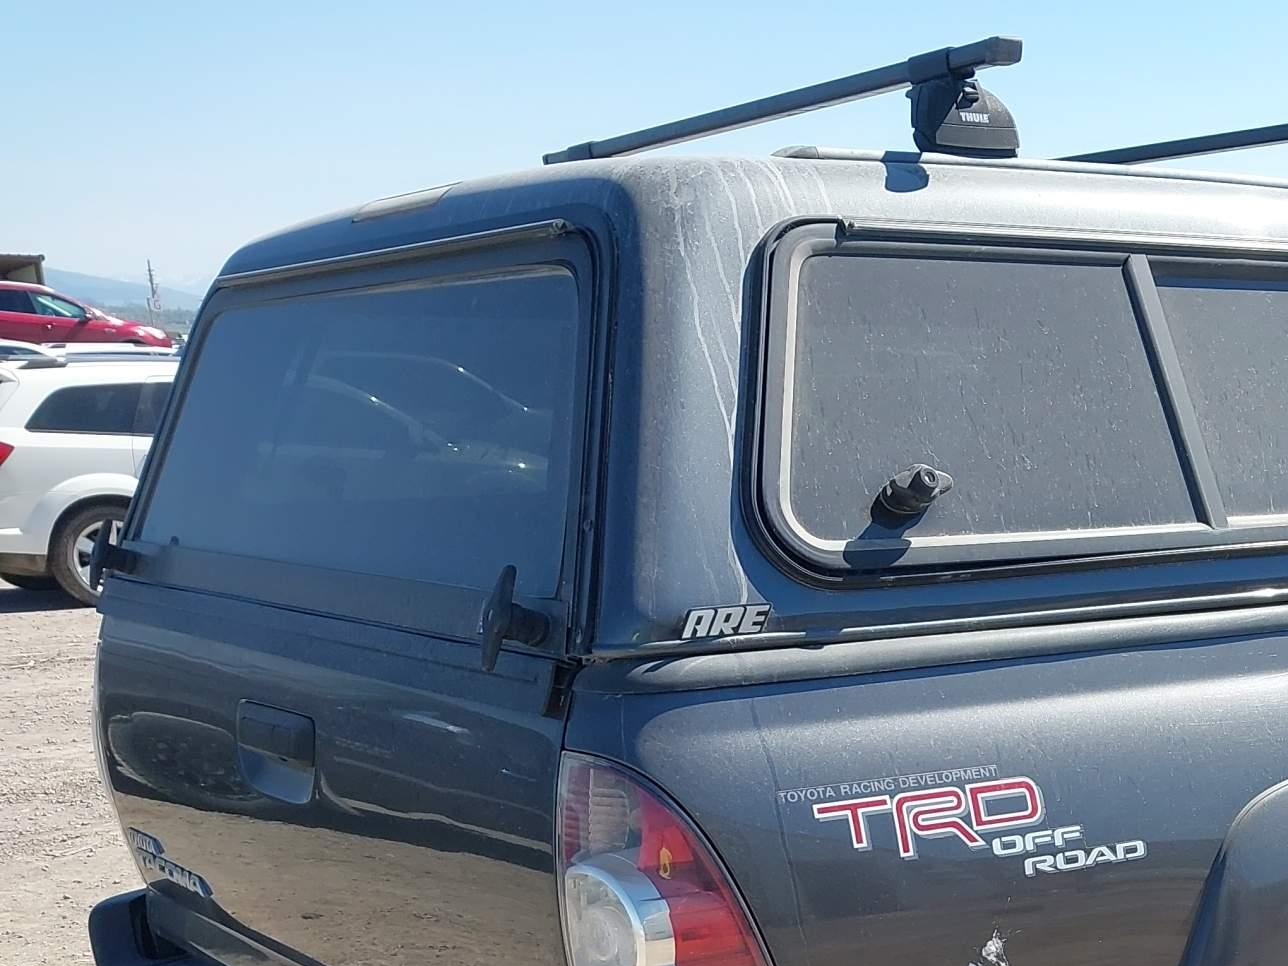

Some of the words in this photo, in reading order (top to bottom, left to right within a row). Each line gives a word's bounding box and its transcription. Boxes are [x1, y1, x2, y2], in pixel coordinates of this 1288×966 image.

[960, 112, 990, 123] THULE
[682, 604, 770, 639] ARE
[778, 786, 836, 803] TOYOTA
[840, 777, 894, 796] RACING
[900, 766, 998, 788] DEVELOPMENT
[812, 776, 1044, 859] TRD
[992, 826, 1083, 857] OFF
[1023, 839, 1148, 877] ROAD
[138, 849, 206, 898] TACOMA
